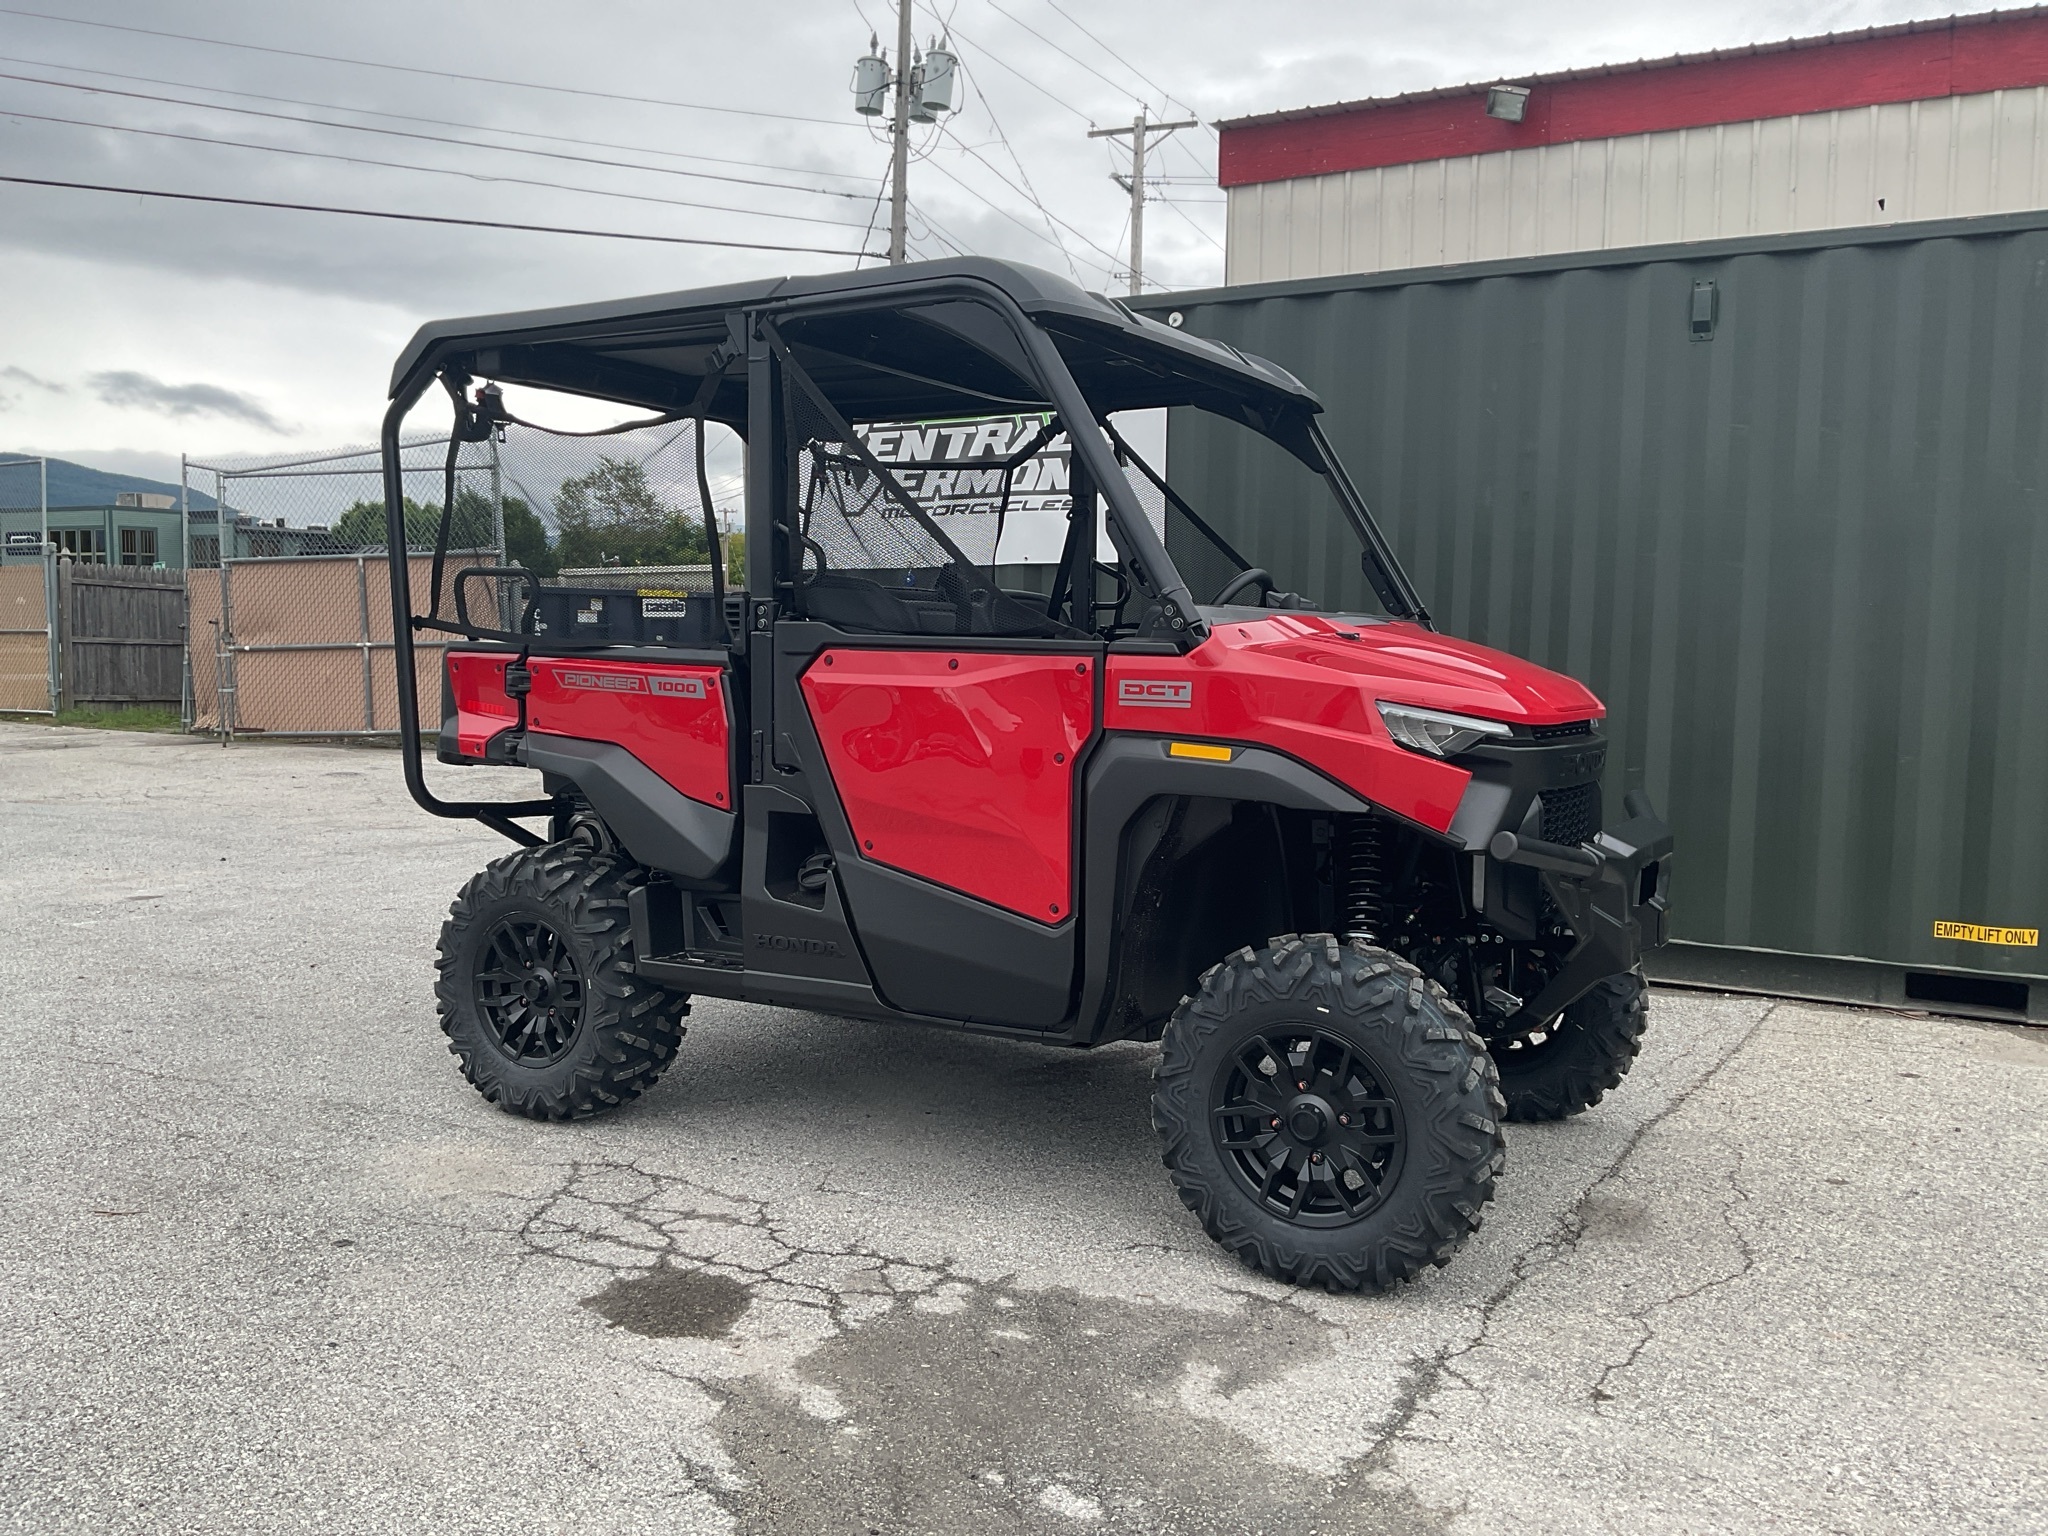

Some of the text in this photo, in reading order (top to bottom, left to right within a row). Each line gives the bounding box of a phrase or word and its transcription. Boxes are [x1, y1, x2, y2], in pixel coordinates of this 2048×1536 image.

[847, 420, 1071, 462] ENTRAL
[564, 673, 697, 694] PIONEER 1000
[1124, 683, 1187, 697] DCT
[1936, 922, 2036, 944] EMPTY LIFT ONLY
[753, 933, 847, 958] HONDA
